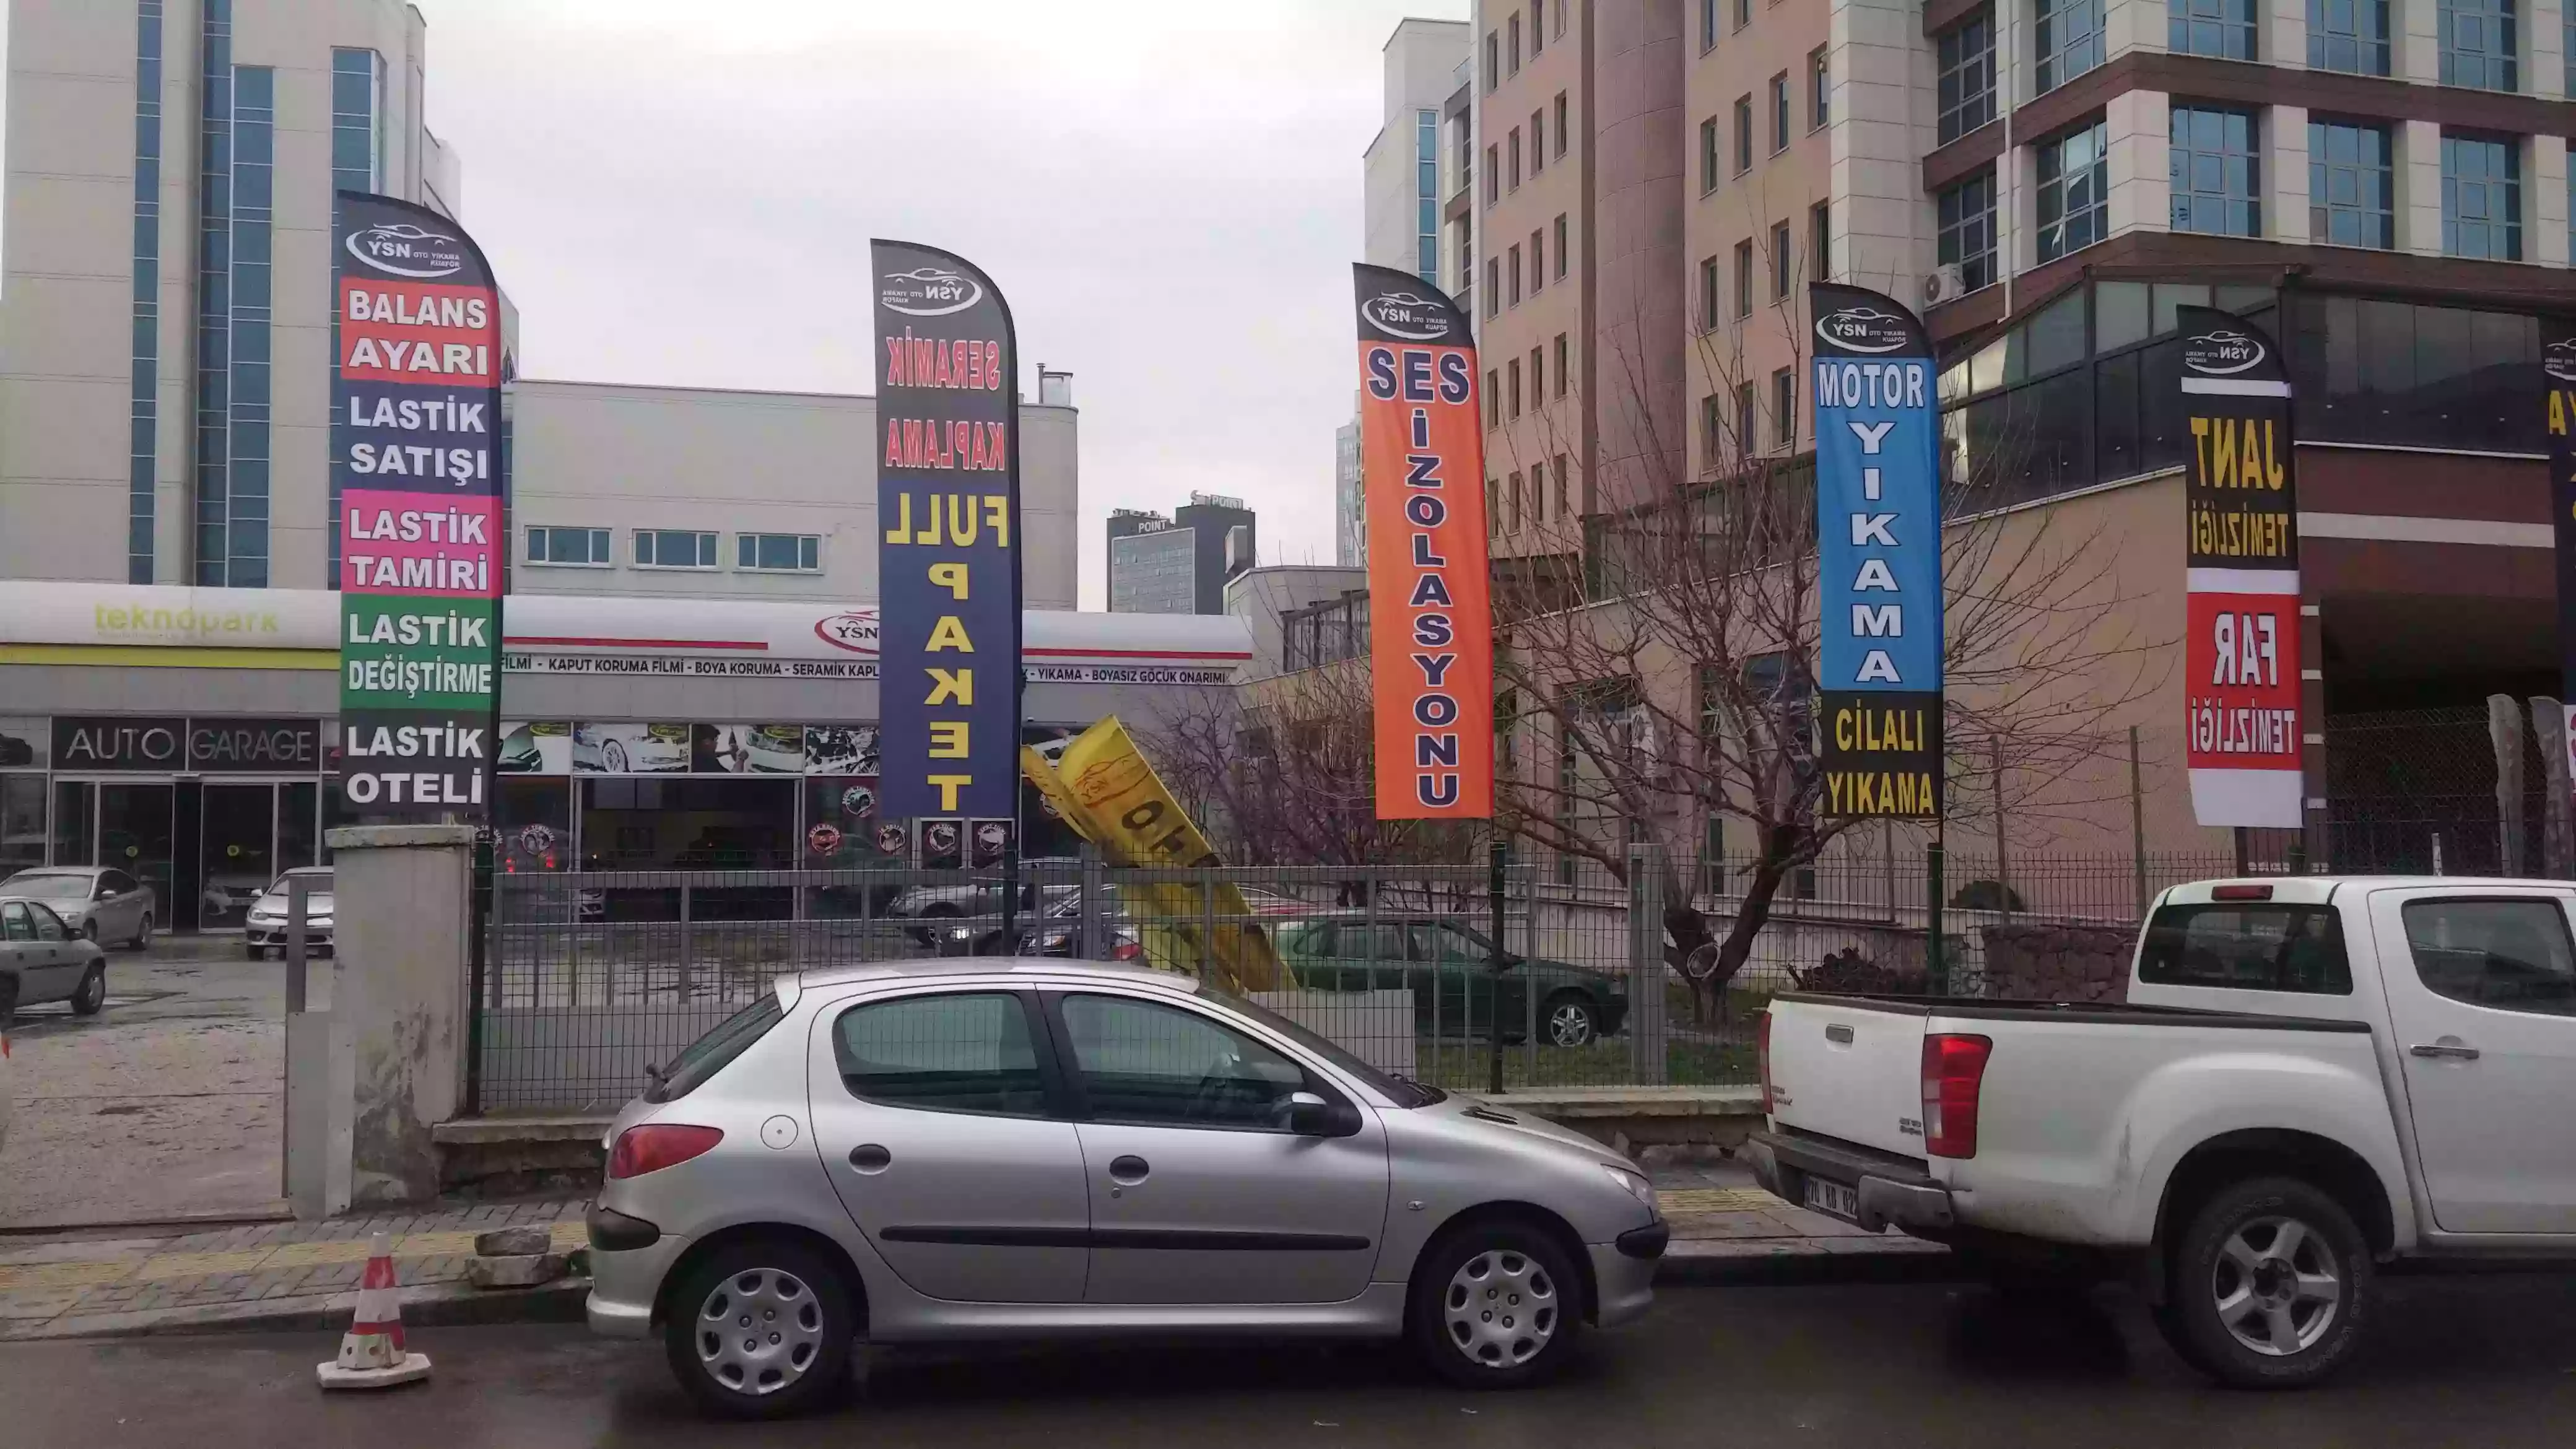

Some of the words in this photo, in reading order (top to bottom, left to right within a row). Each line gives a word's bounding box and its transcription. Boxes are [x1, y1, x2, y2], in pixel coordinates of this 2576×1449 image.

[367, 240, 411, 259] YSN
[348, 289, 488, 329] BALANS
[1377, 307, 1411, 322] YSN
[1833, 324, 1867, 336] YSN
[348, 337, 489, 376] AYARI
[1366, 346, 1471, 406] SES
[1817, 361, 1925, 409] MOTOR
[350, 394, 487, 433] LASTİK
[350, 442, 488, 487] SATIŞI
[349, 507, 487, 545] LASTİK
[1139, 520, 1167, 533] POINT
[348, 552, 488, 591] TAMİRİ
[1847, 421, 1904, 684] YIKAMA
[94, 603, 279, 635] teknopark
[349, 609, 487, 648] LASTİK
[835, 626, 879, 638] YSN
[348, 653, 492, 699] DEĞİŞTİRME
[549, 658, 592, 671] KAPUT
[595, 659, 649, 672] KORUMA
[652, 657, 684, 672] FİLMİ
[695, 662, 727, 674] BOYA
[730, 663, 781, 674] KORUMA
[793, 661, 845, 676] SERAMİK
[1038, 668, 1083, 680] YIKAMA
[1092, 669, 1137, 681] BOYASIZ
[347, 721, 484, 759] LASTİK
[1835, 698, 1925, 752] CİLALI
[65, 728, 176, 760] AUTO
[189, 730, 312, 762] GARAGE
[347, 768, 482, 804] OTELİ
[1826, 772, 1936, 815] YIKAMA
